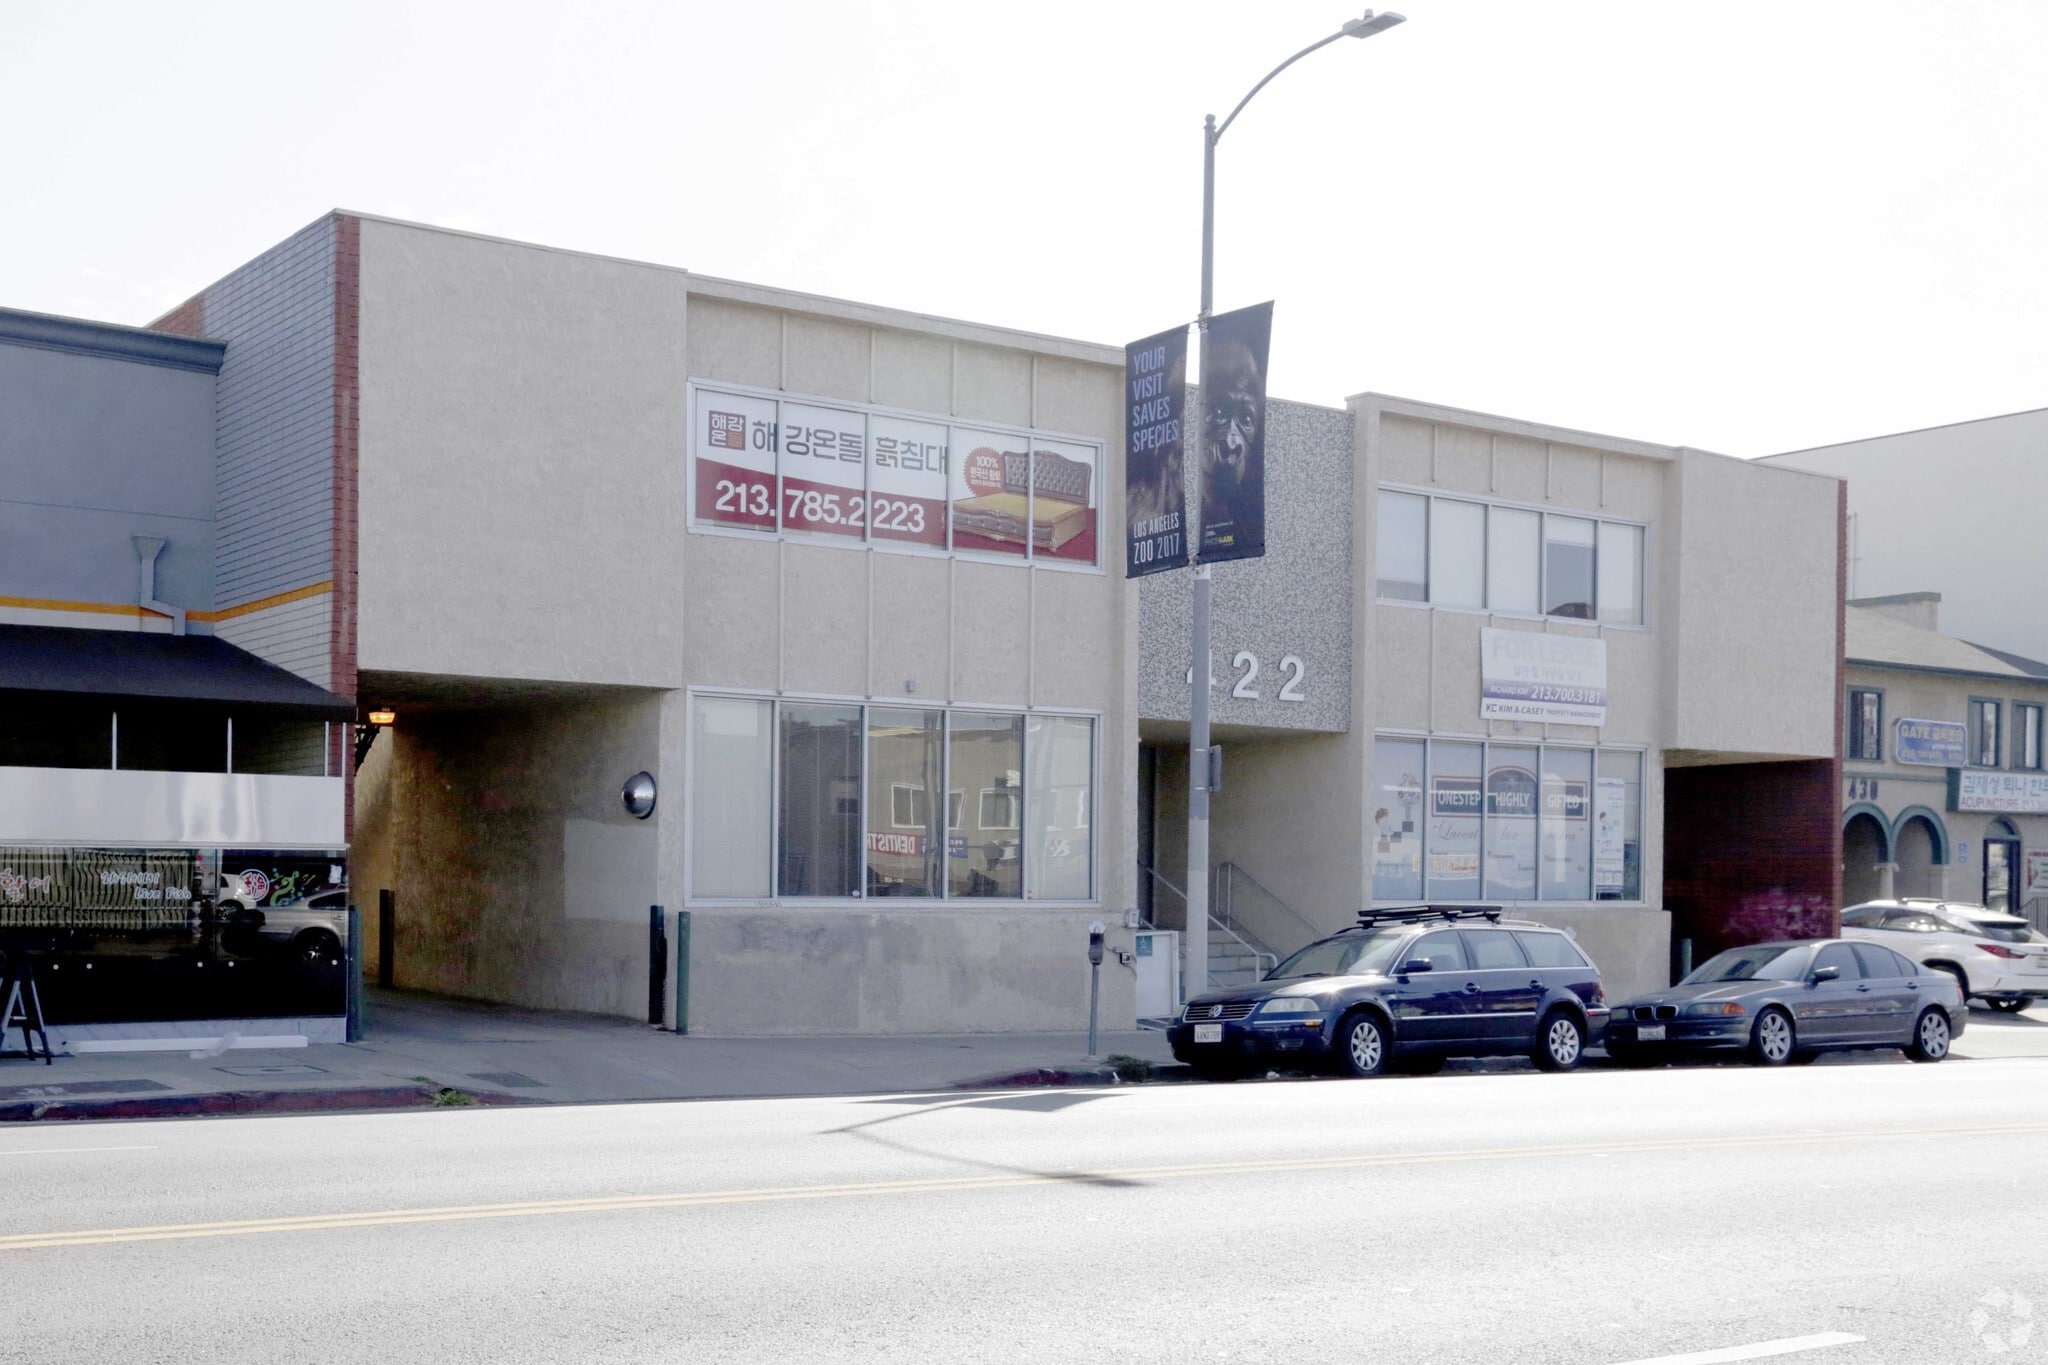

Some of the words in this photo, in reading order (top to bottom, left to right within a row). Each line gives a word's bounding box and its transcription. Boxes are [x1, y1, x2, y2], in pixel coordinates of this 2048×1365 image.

[1133, 346, 1165, 375] YOUR
[1133, 373, 1164, 400] VISIT
[1133, 396, 1170, 427] SAVES
[1133, 420, 1179, 454] SPECIES
[875, 436, 949, 475] 흙침대
[976, 456, 999, 469] 100%
[1134, 522, 1147, 538] LOS
[1149, 512, 1180, 535] ANGELES
[1134, 540, 1153, 564] ZOO
[1157, 533, 1180, 559] 2017
[1490, 685, 1516, 694] RICHARD
[1531, 685, 1600, 704] 213.700.3181
[1498, 704, 1512, 713] KIM
[1521, 706, 1544, 715] CASEY
[1901, 725, 1930, 739] GATE
[1438, 790, 1481, 806] ONESTEP
[1495, 793, 1530, 808] HIGHLY
[1548, 794, 1580, 809] GIFTED
[1961, 797, 2018, 809] ACUPUNCTURE
